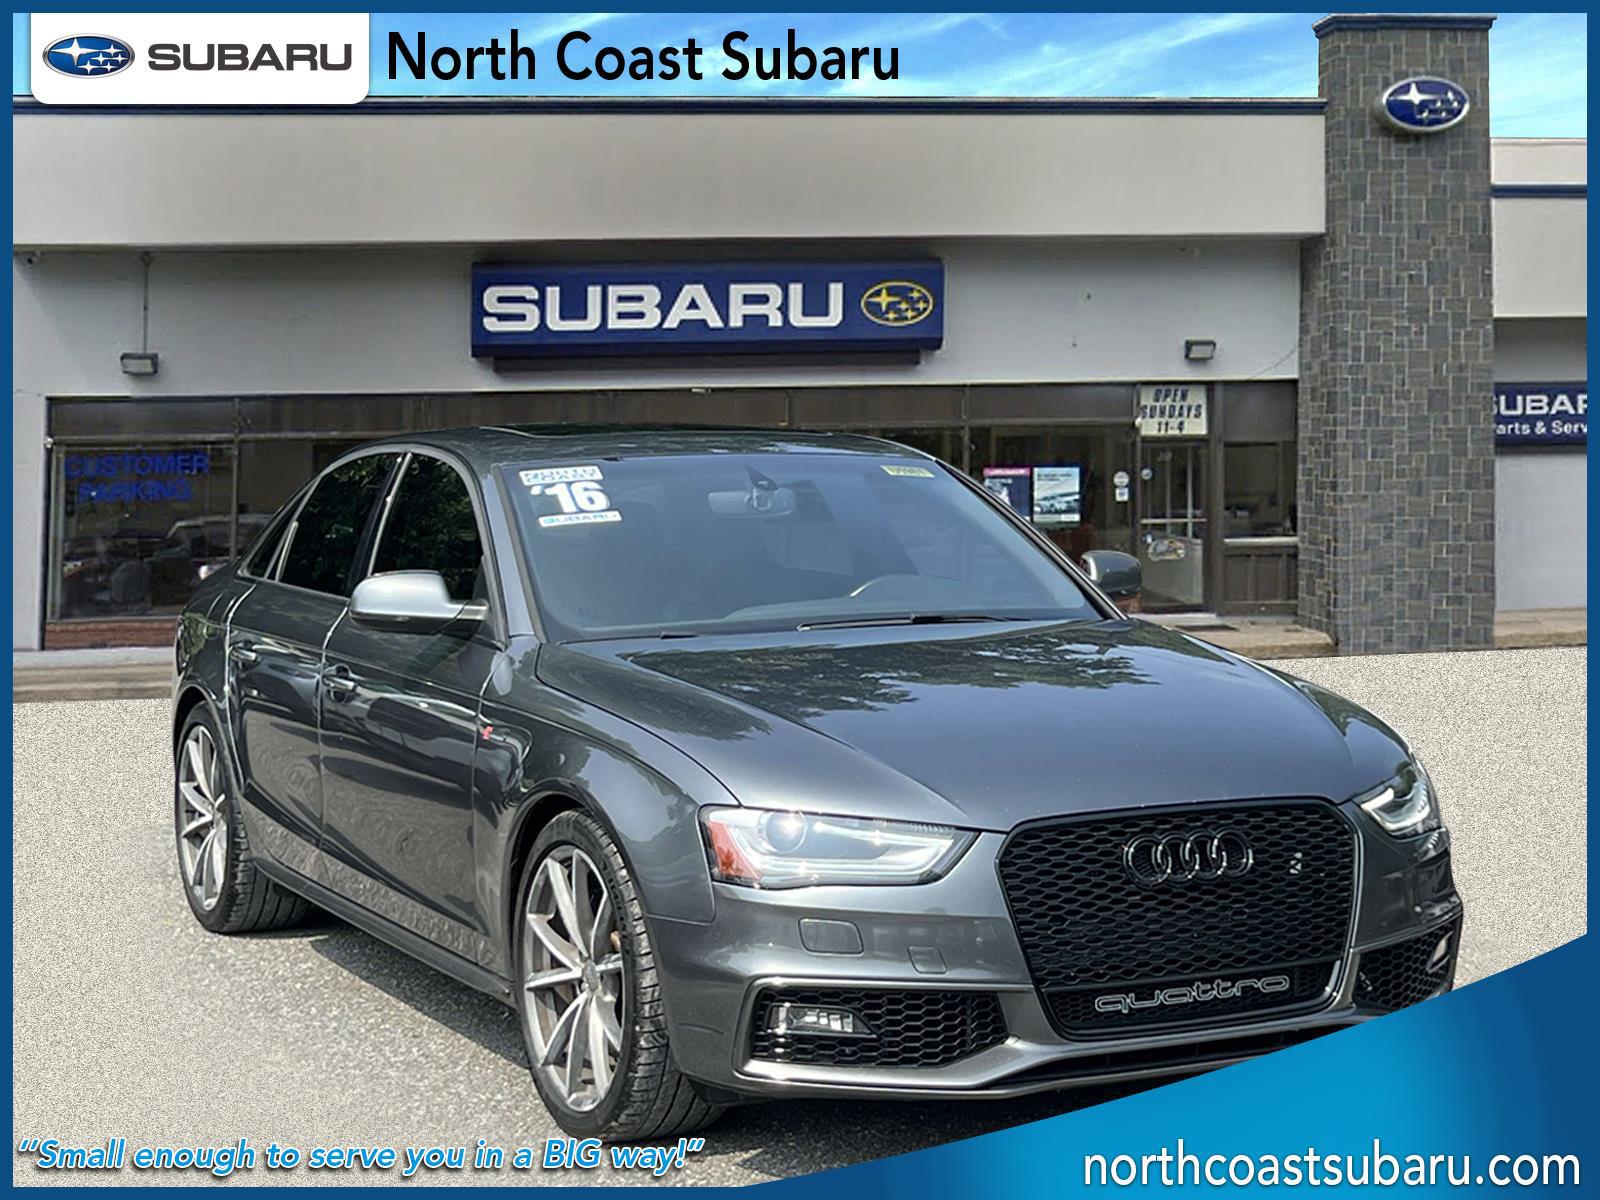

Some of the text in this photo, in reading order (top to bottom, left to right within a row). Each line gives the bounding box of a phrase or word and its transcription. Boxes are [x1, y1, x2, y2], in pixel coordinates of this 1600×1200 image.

[482, 282, 845, 333] SUBARU
[1153, 388, 1189, 402] OPEN
[1140, 404, 1203, 419] SUNDAYS
[1494, 421, 1531, 435] arts
[1534, 420, 1547, 435] &
[64, 453, 209, 479] CUSTOMER
[1094, 975, 1290, 1013] quattro
